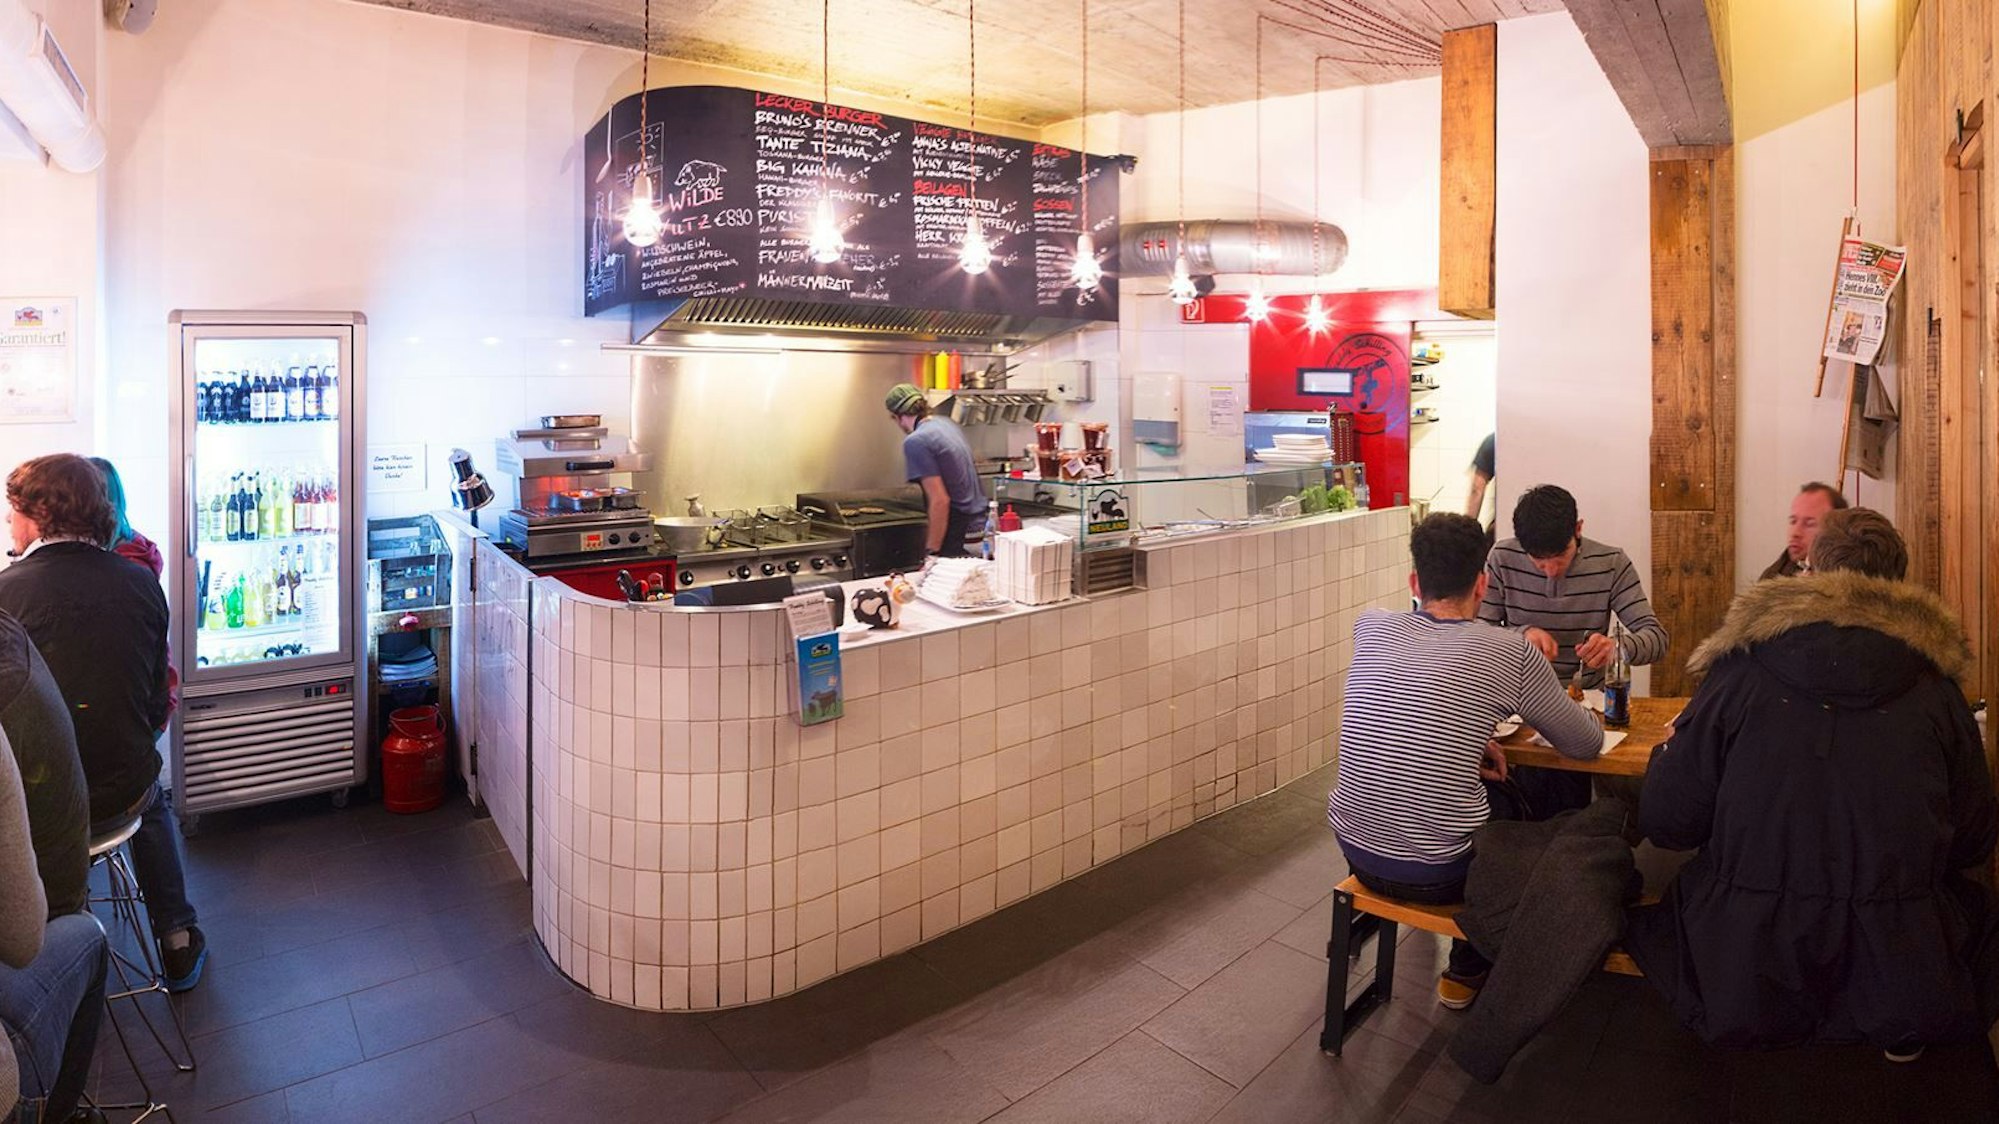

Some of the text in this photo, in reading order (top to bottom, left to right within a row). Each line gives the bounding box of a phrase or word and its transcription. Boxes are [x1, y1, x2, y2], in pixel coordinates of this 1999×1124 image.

[755, 91, 888, 129] LECKER BURGER
[813, 118, 882, 141] BRENNER
[755, 134, 805, 151] TANTE
[911, 135, 948, 151] ANNA'S
[756, 159, 785, 174] BIG
[912, 156, 945, 169] VICKY
[912, 180, 967, 197] BEILAGEN
[915, 229, 946, 242] HERR
